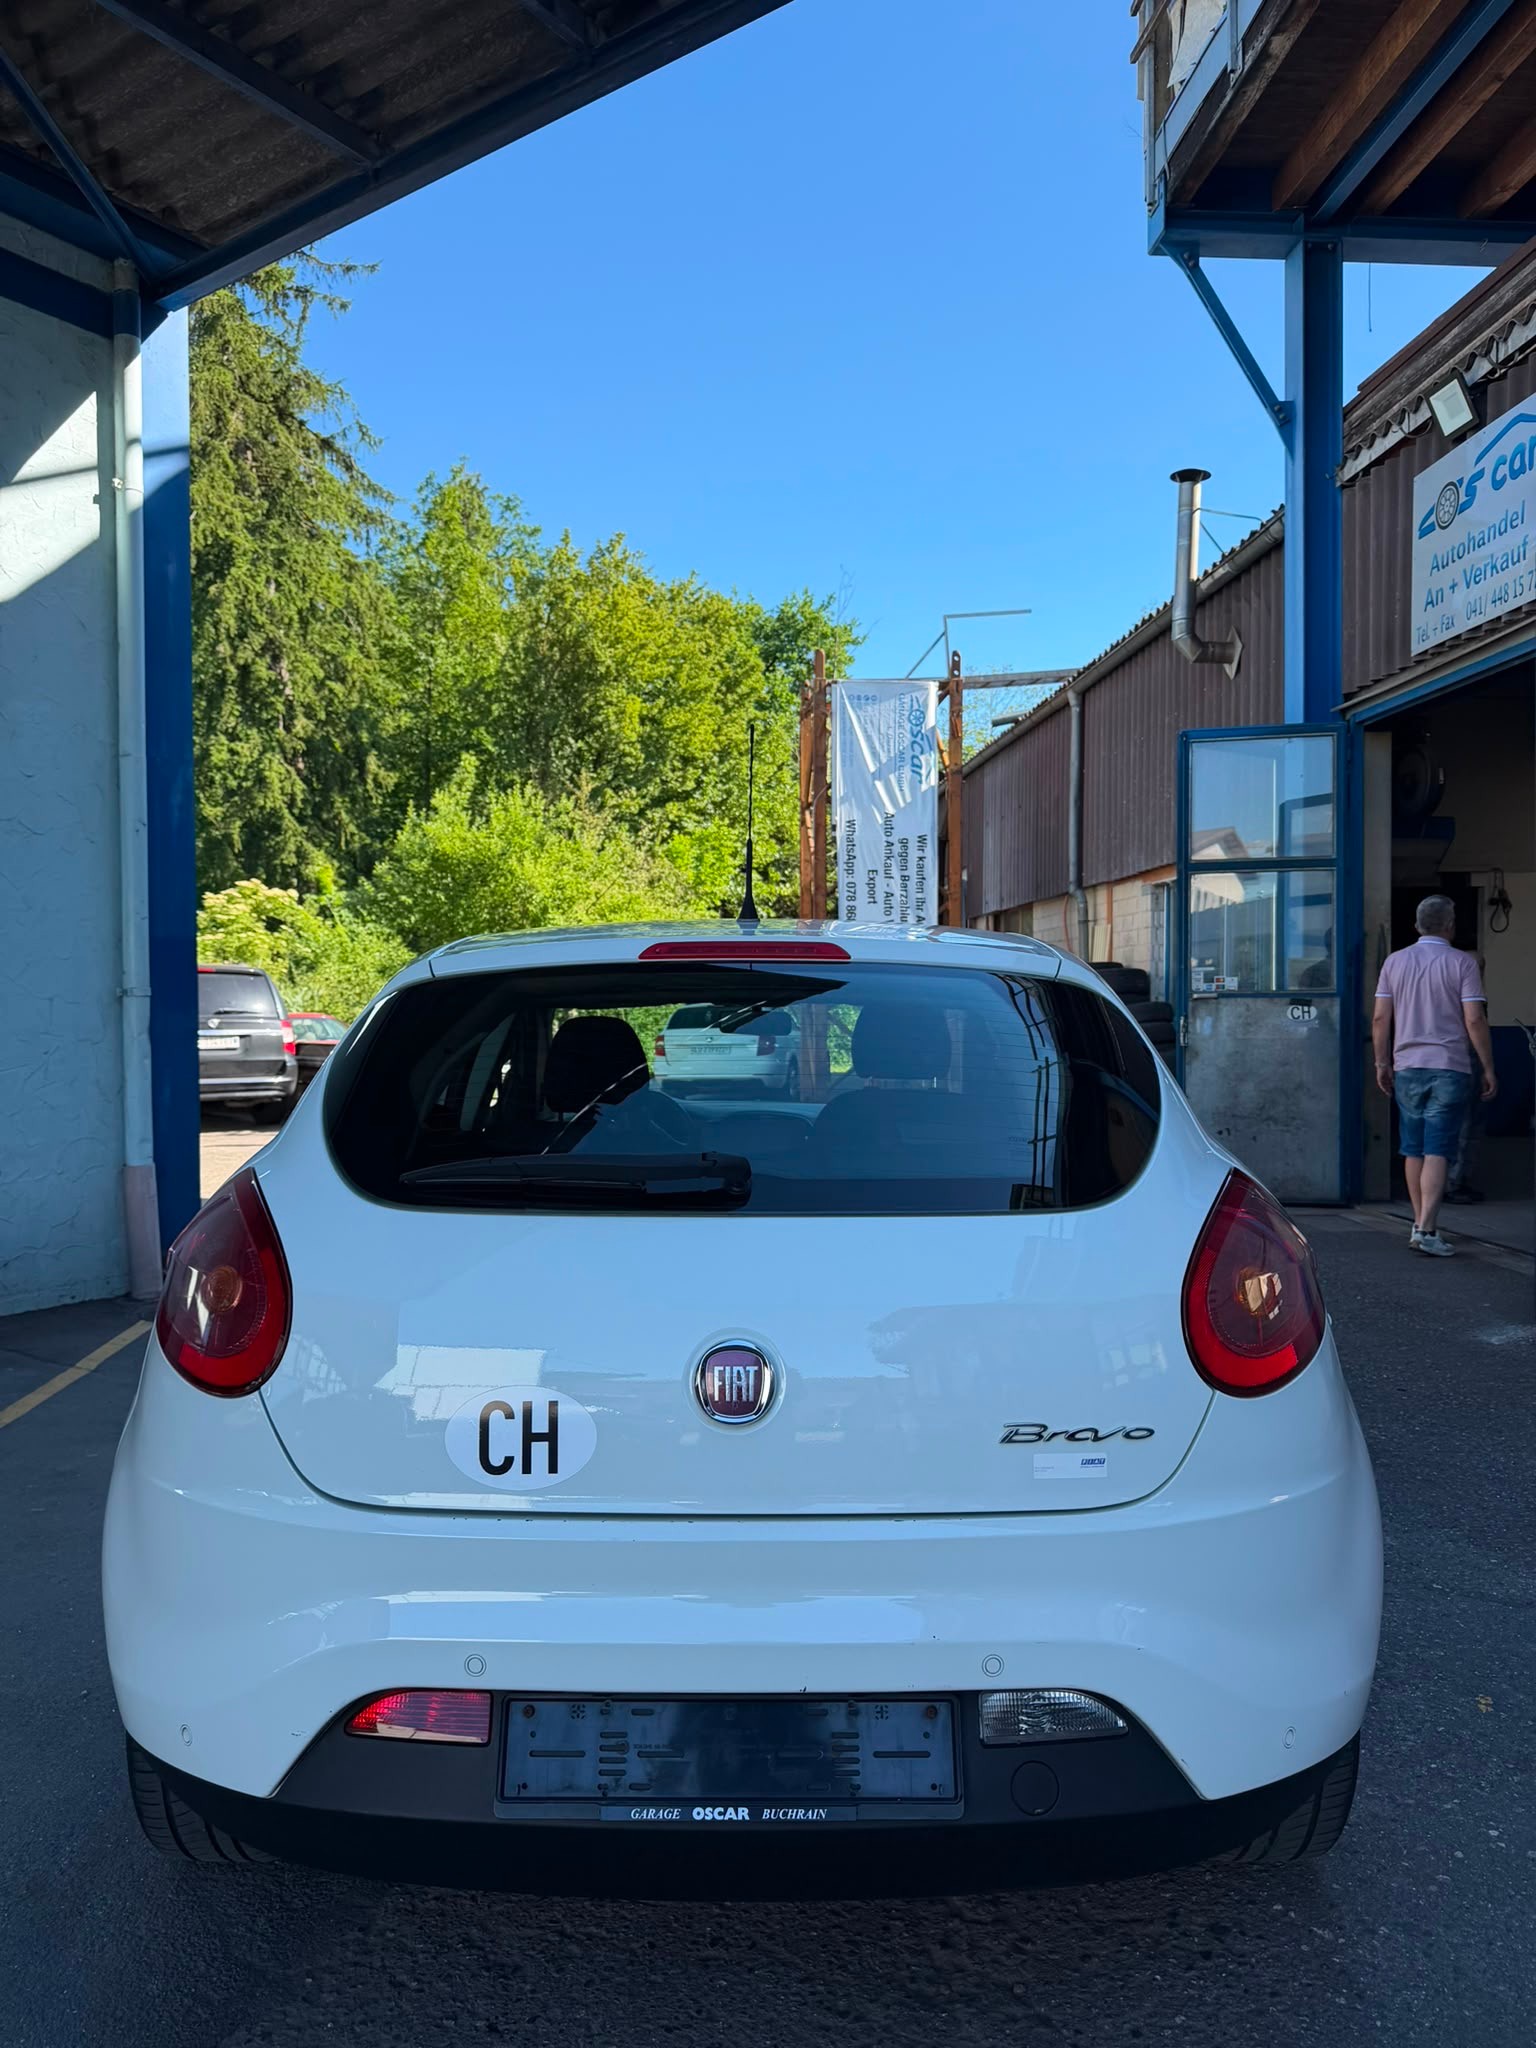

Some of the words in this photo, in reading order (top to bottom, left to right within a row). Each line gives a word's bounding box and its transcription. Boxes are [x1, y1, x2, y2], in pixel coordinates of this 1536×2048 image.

[1430, 500, 1525, 577] Autohandel
[1424, 587, 1444, 612] An
[1449, 579, 1458, 594] +
[1462, 534, 1529, 589] Verkauf
[1440, 614, 1455, 634] Fax
[1491, 583, 1509, 608] 448
[1513, 575, 1524, 599] 15
[1528, 567, 1536, 592] 7
[884, 812, 895, 837] Auto
[844, 819, 857, 878] WhatsApp:
[884, 840, 895, 880] Ankauf
[898, 837, 909, 871] gegen
[917, 834, 927, 853] Wir
[846, 881, 856, 902] 078
[865, 869, 877, 905] Export
[916, 856, 926, 894] kaufen
[884, 891, 894, 917] Auto
[1291, 1006, 1311, 1020] CH
[714, 1366, 759, 1402] FIAT
[478, 1400, 559, 1476] CH
[999, 1422, 1155, 1444] Bravo
[631, 1808, 681, 1820] GARAGE
[692, 1807, 750, 1821] OSCAR
[762, 1808, 827, 1820] BUCHRAIN
